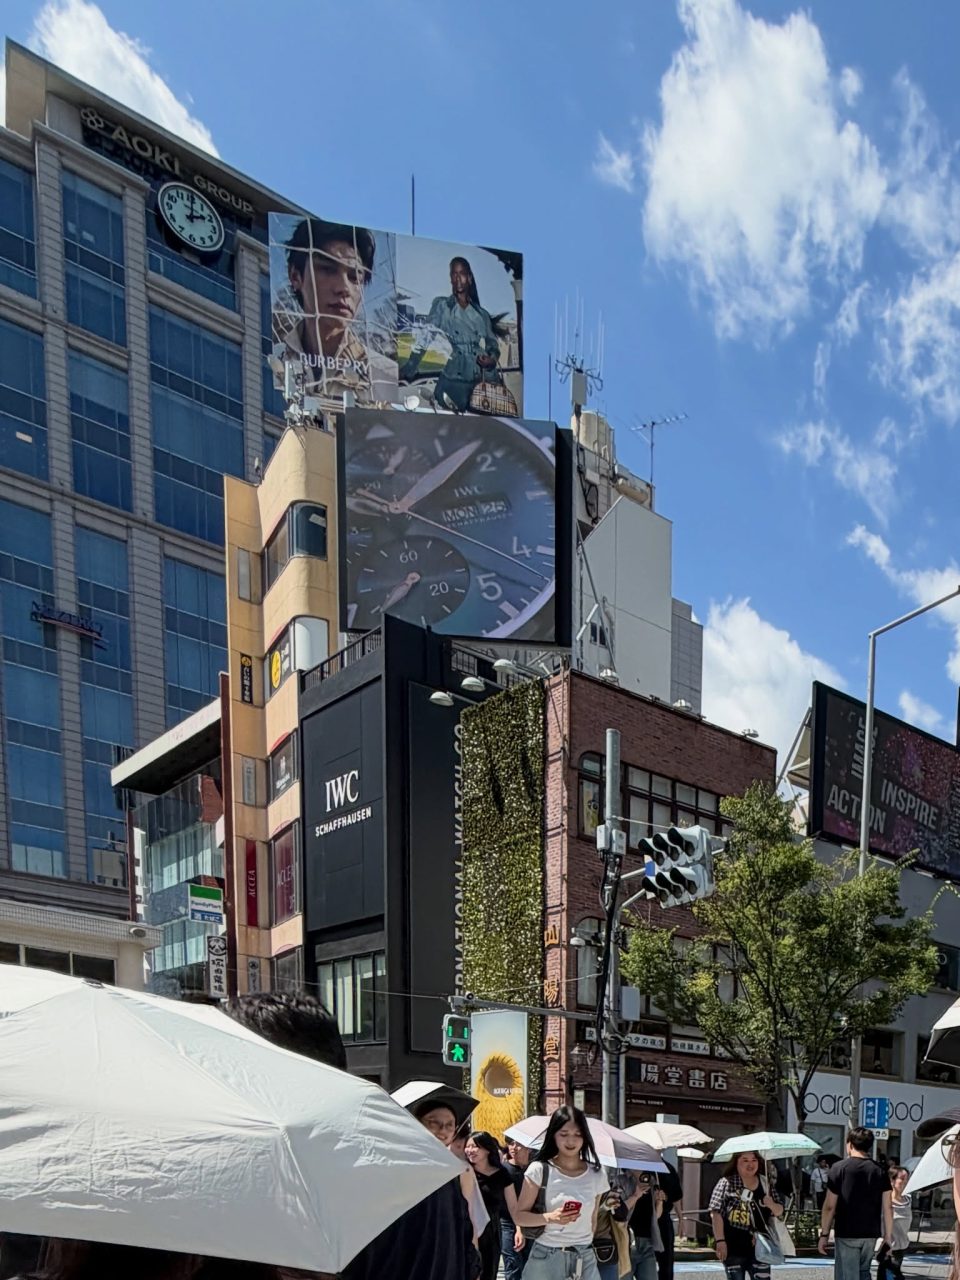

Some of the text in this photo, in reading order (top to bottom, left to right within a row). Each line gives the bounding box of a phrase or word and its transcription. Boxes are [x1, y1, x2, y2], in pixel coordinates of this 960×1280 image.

[111, 126, 254, 214] AOKI GROUP
[300, 352, 370, 374] BURBERRY
[399, 550, 418, 564] 60
[429, 581, 450, 597] 20
[477, 572, 503, 601] 5
[325, 769, 359, 813] IWC
[880, 778, 940, 830] INSPIRE
[315, 806, 372, 838] SCHAFFHAUSEN
[827, 784, 887, 834] ACTON
[247, 869, 257, 899] ACCEA
